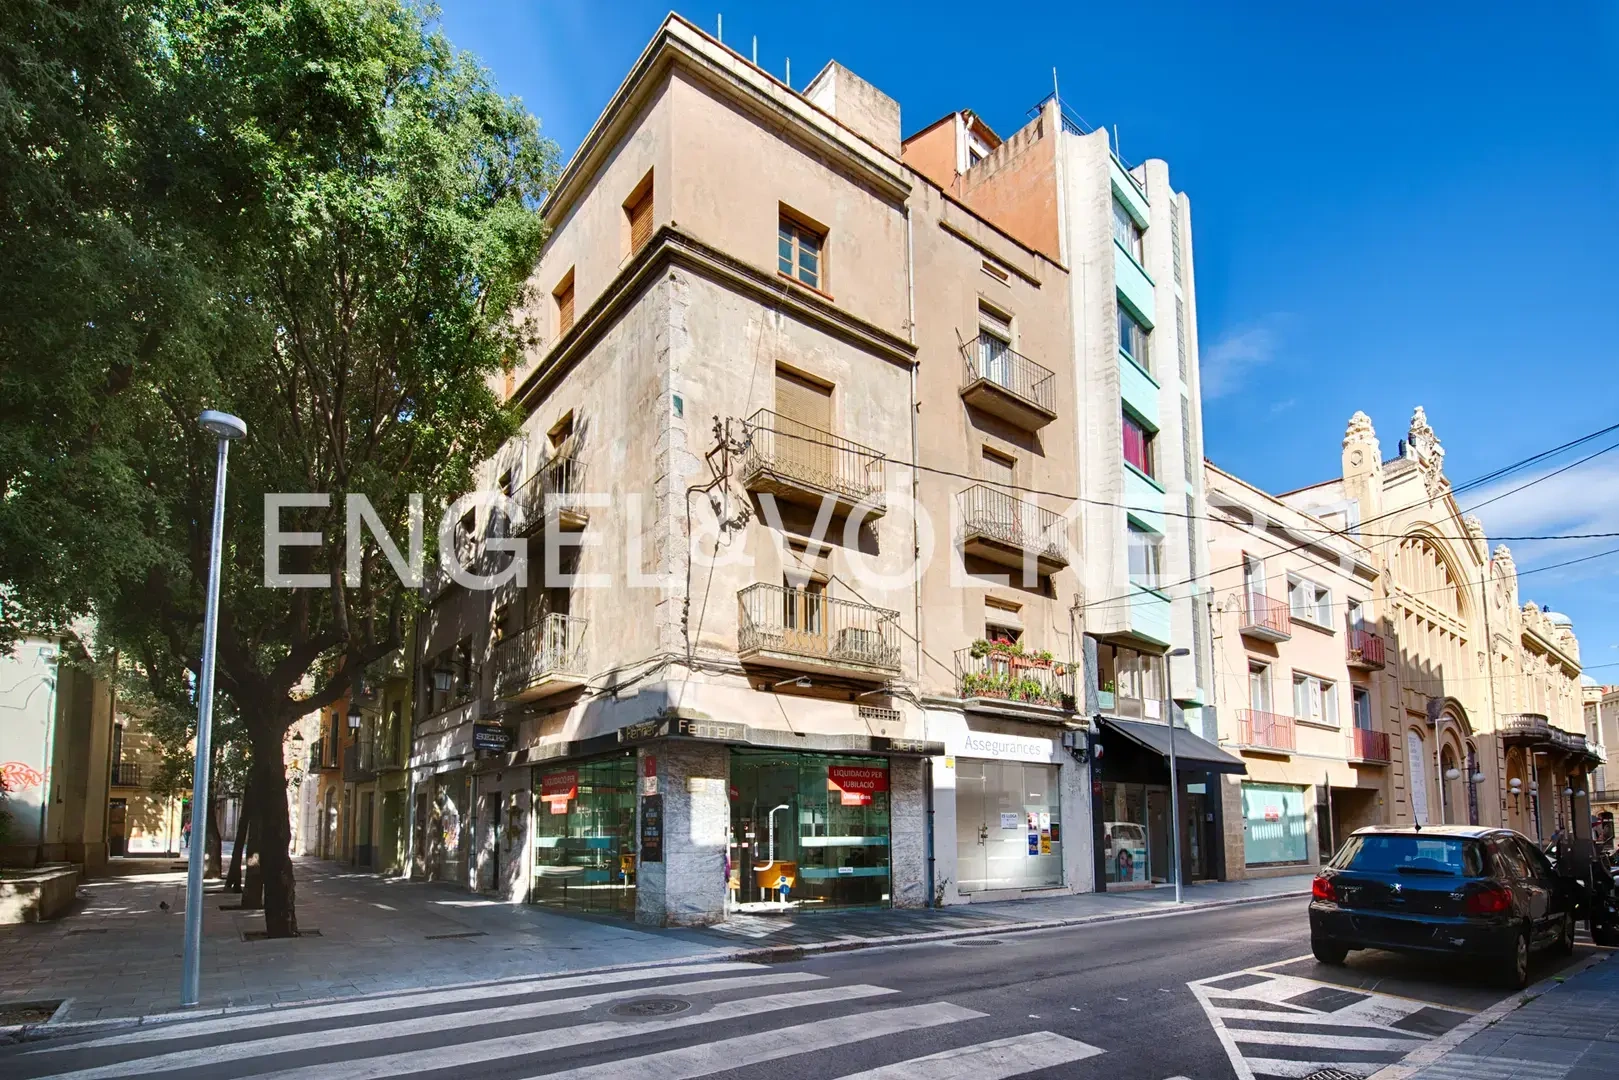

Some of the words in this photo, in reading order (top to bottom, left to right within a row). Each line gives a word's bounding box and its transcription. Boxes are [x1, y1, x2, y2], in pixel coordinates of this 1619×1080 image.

[626, 723, 658, 740] Ferrer
[678, 719, 737, 738] Ferrer
[476, 732, 510, 743] SEIKO
[886, 738, 924, 753] Joieria
[965, 735, 1041, 756] Assegurances
[833, 769, 870, 778] LIQUIDACIÓ
[843, 780, 875, 789] JUBILACIÓ
